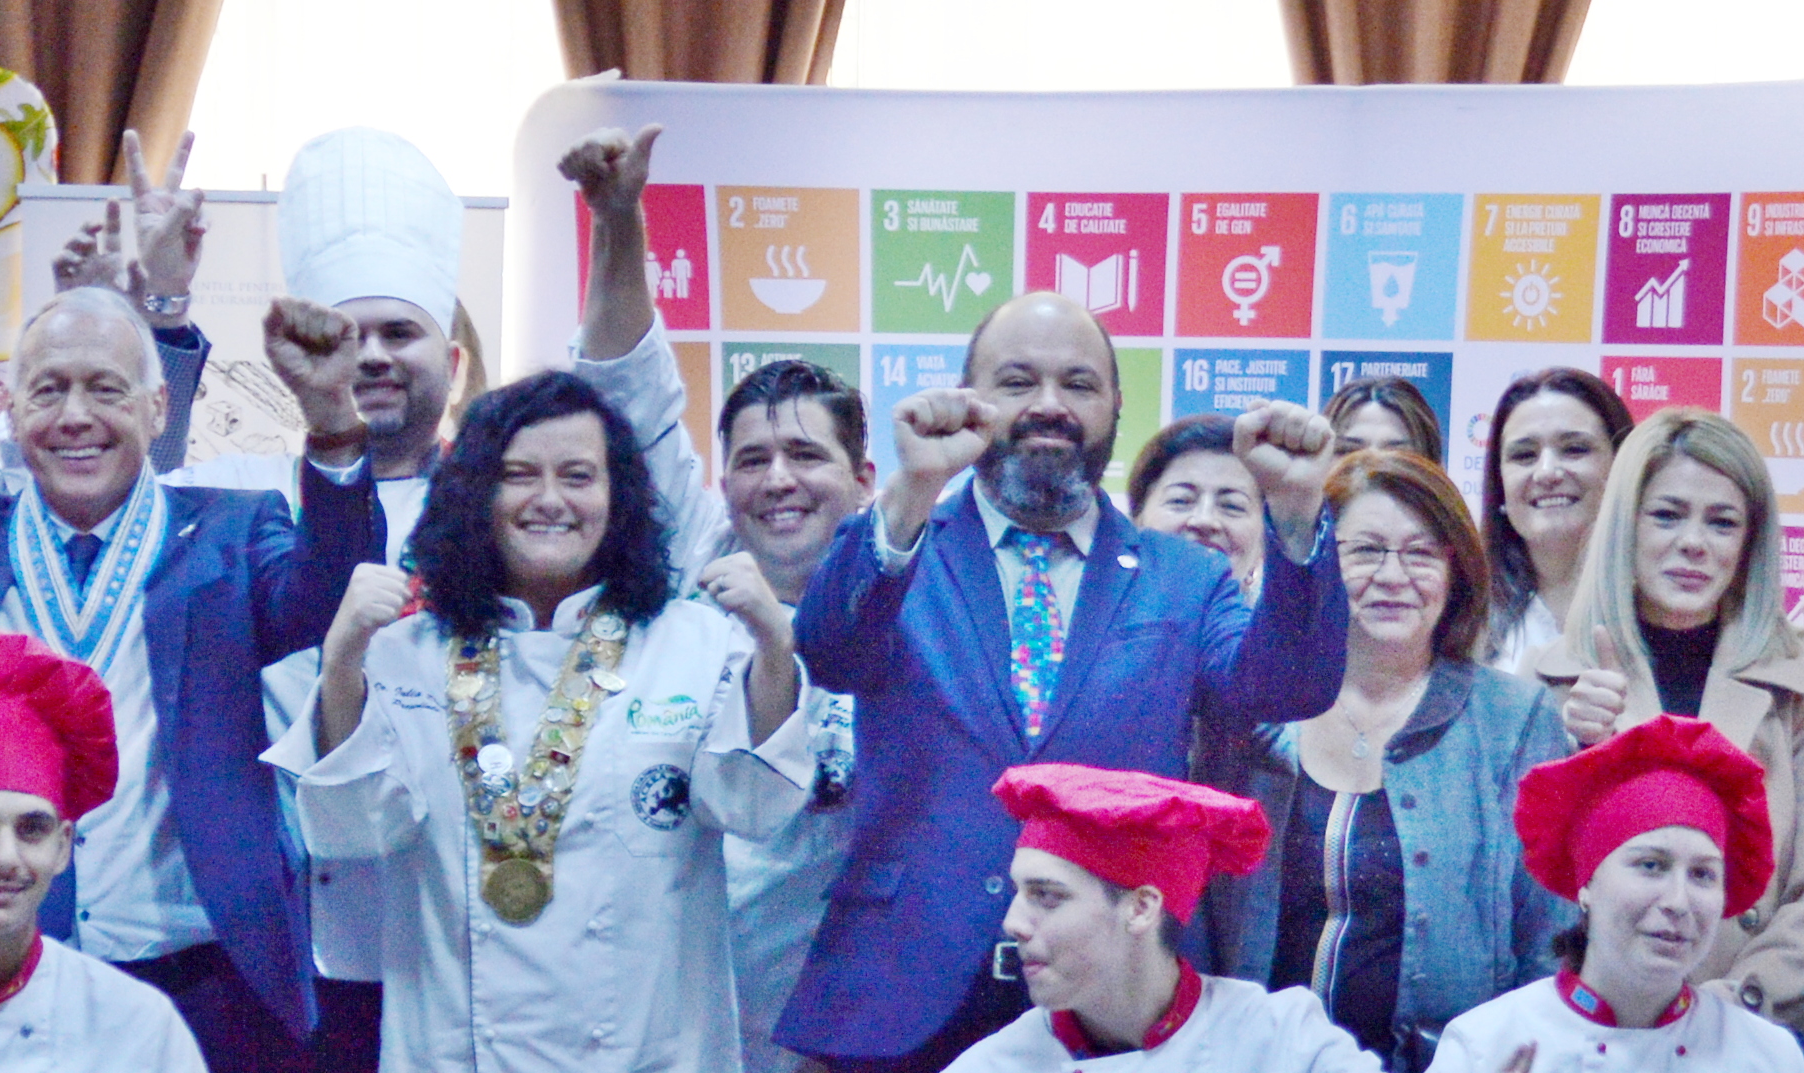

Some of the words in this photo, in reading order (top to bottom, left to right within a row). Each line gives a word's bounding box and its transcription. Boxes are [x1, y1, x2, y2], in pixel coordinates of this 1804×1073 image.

[728, 195, 745, 228] 2
[883, 200, 900, 232] 3
[1038, 202, 1056, 234] 4
[1191, 203, 1208, 235] 5
[1216, 203, 1267, 217] EGALITATE
[1340, 204, 1356, 235] 6
[1484, 204, 1499, 237] 7
[1618, 204, 1634, 238] 8
[1746, 203, 1761, 236] 9
[1064, 219, 1078, 233] DE
[1080, 219, 1127, 234] CALITATE
[1215, 220, 1229, 234] DE
[1231, 220, 1252, 235] GEN
[880, 355, 907, 386] 14
[1182, 359, 1209, 391] 16
[1331, 362, 1354, 393] 17
[1361, 362, 1428, 378] PARTENERIATE
[1612, 367, 1623, 397] 1
[1741, 369, 1755, 403] 2
